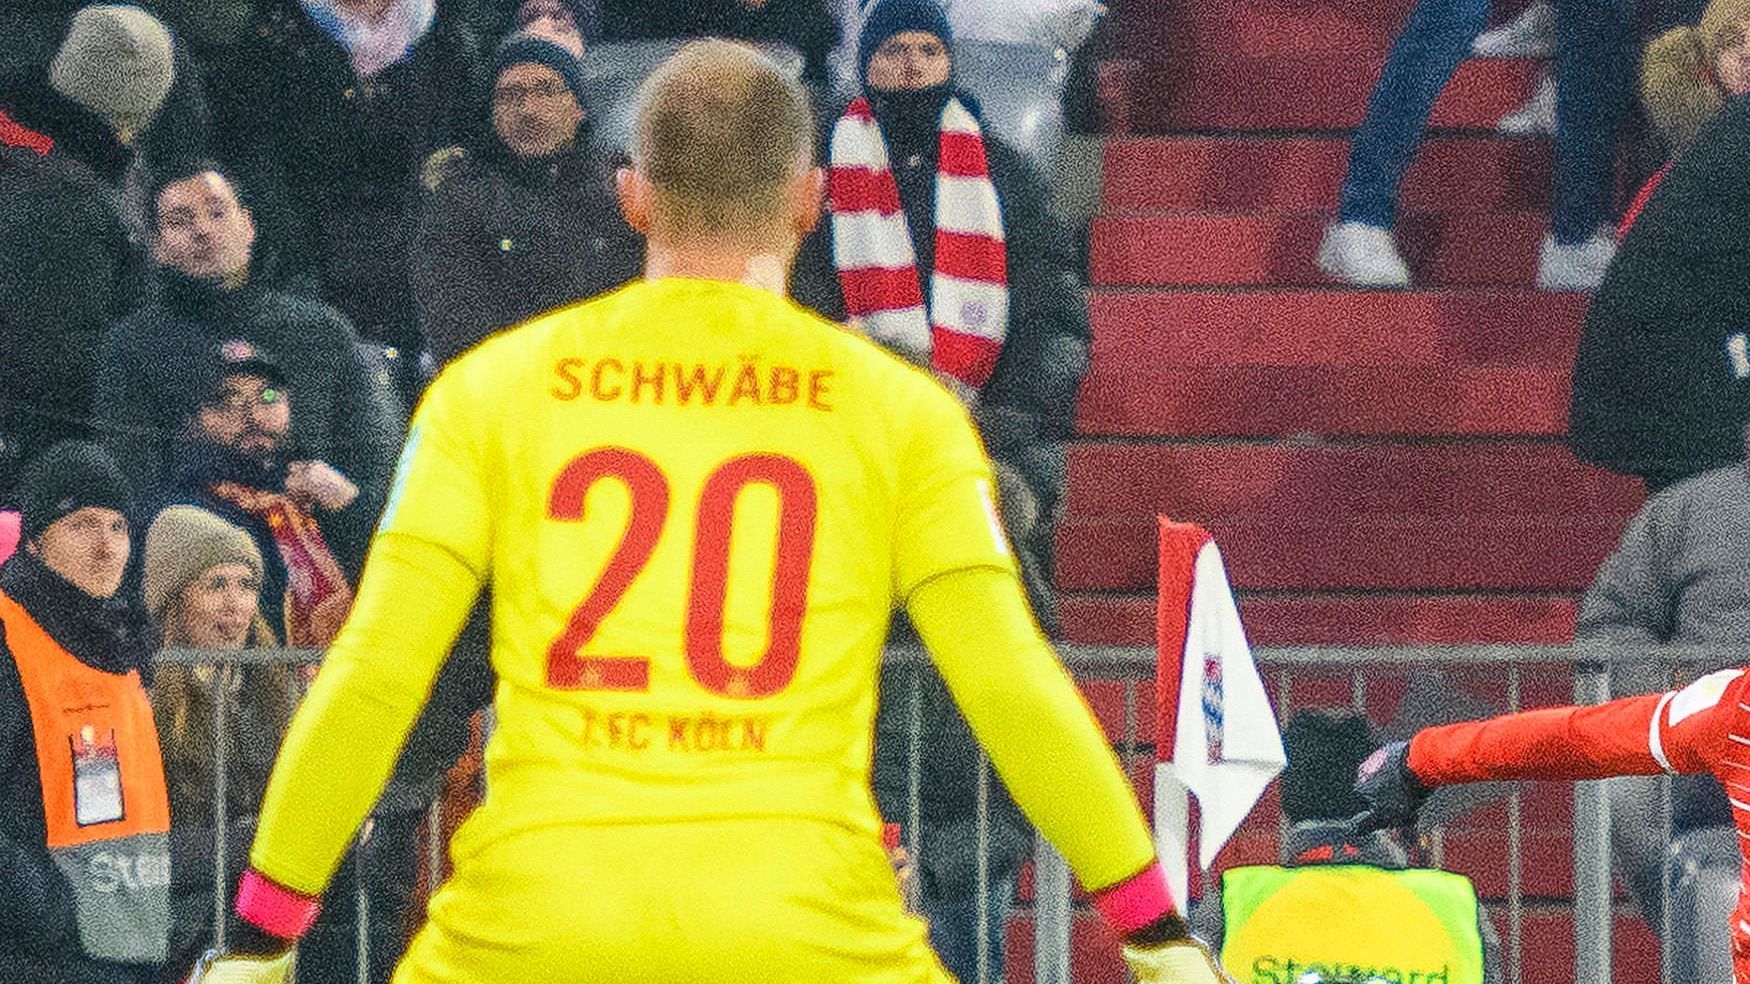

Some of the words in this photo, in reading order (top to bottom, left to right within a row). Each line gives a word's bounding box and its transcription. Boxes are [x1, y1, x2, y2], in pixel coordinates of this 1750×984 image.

[549, 355, 834, 412] SCHWÄBE
[545, 445, 818, 701] 20
[666, 710, 768, 753] KÖLN
